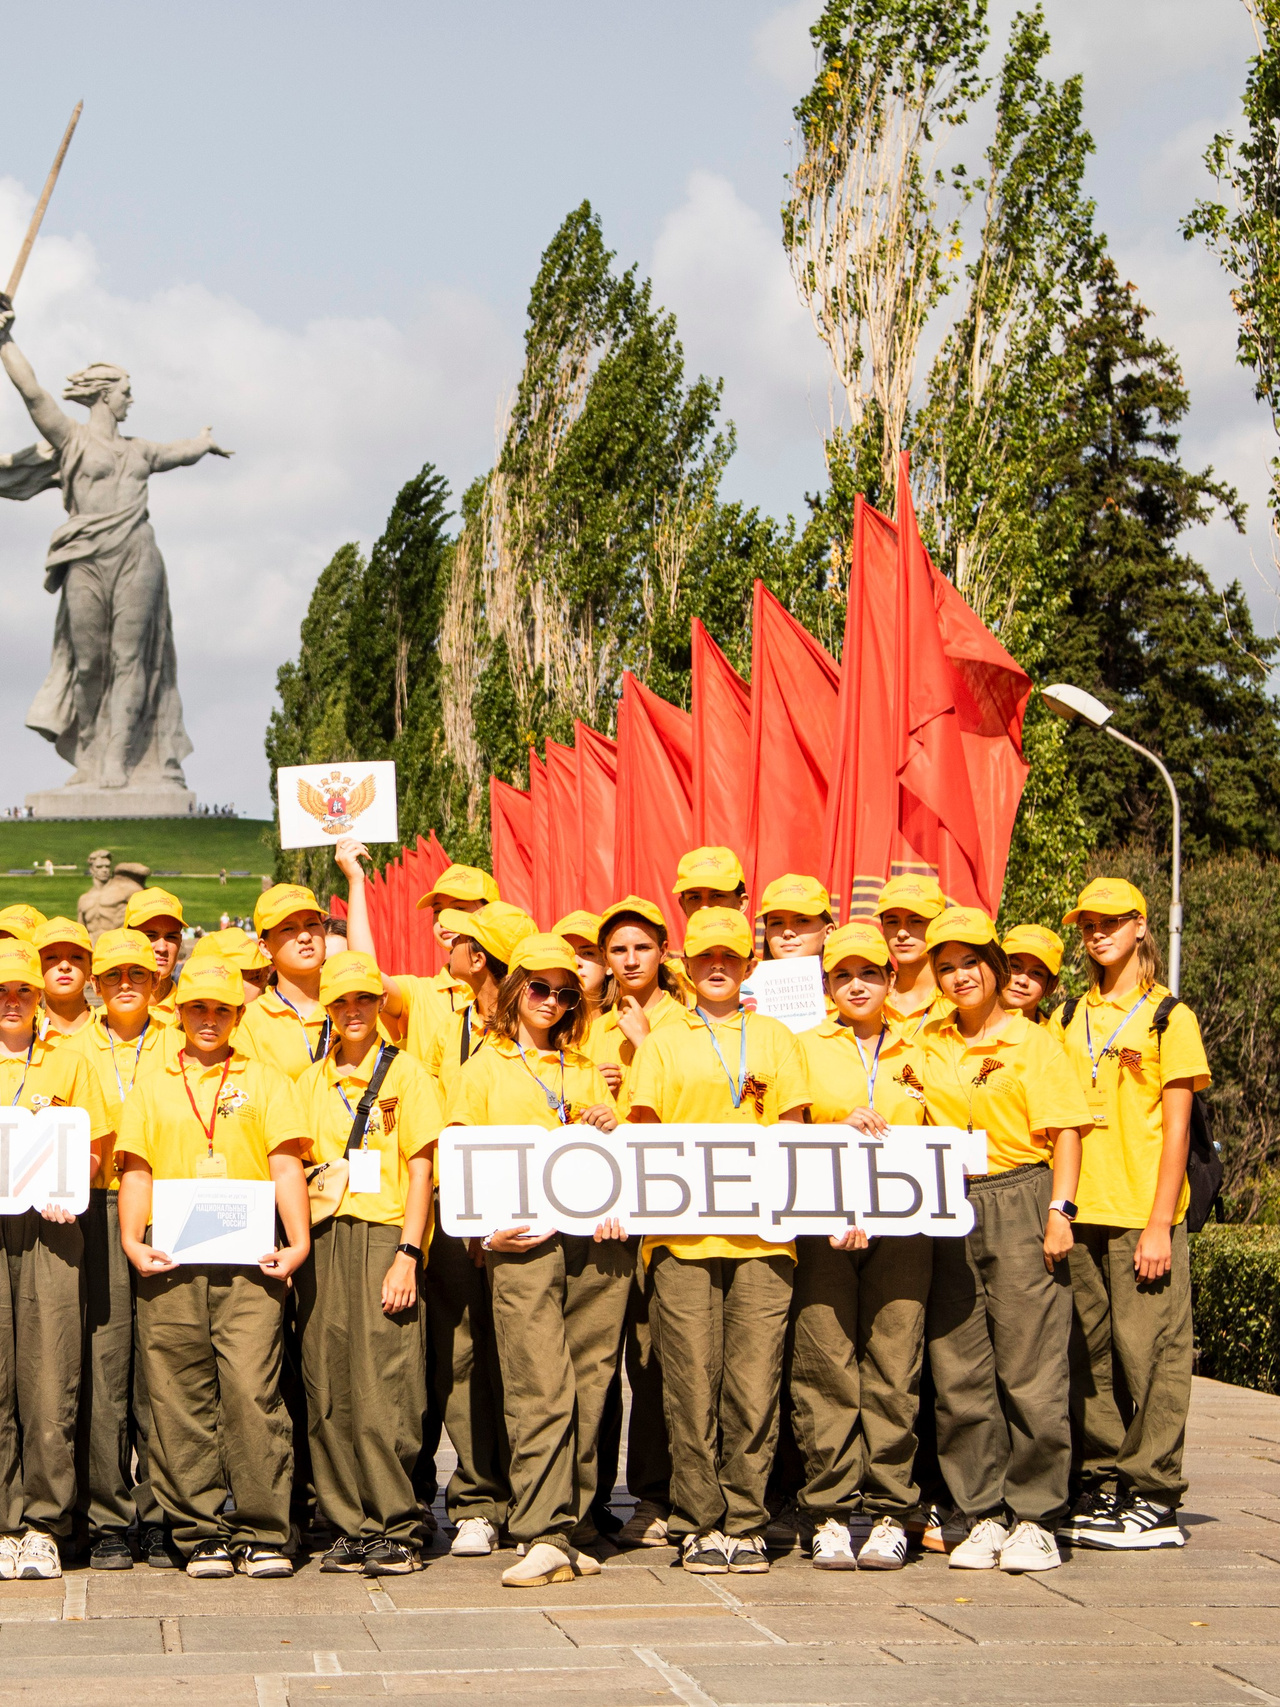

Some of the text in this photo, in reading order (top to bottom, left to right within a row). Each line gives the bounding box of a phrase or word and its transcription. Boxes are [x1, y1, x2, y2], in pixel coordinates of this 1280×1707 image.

[764, 975, 814, 986] АГЕНТСТВО
[764, 984, 814, 996] РАЗВИТИЯ
[767, 1000, 817, 1012] ТУРИЗМА
[454, 1141, 957, 1226] ПОБЕДЫ
[196, 1204, 246, 1212] НАЦИОНАЛЬНЫЕ
[217, 1211, 247, 1220] ПРОЕКТЫ
[222, 1219, 247, 1228] РОССИИ
